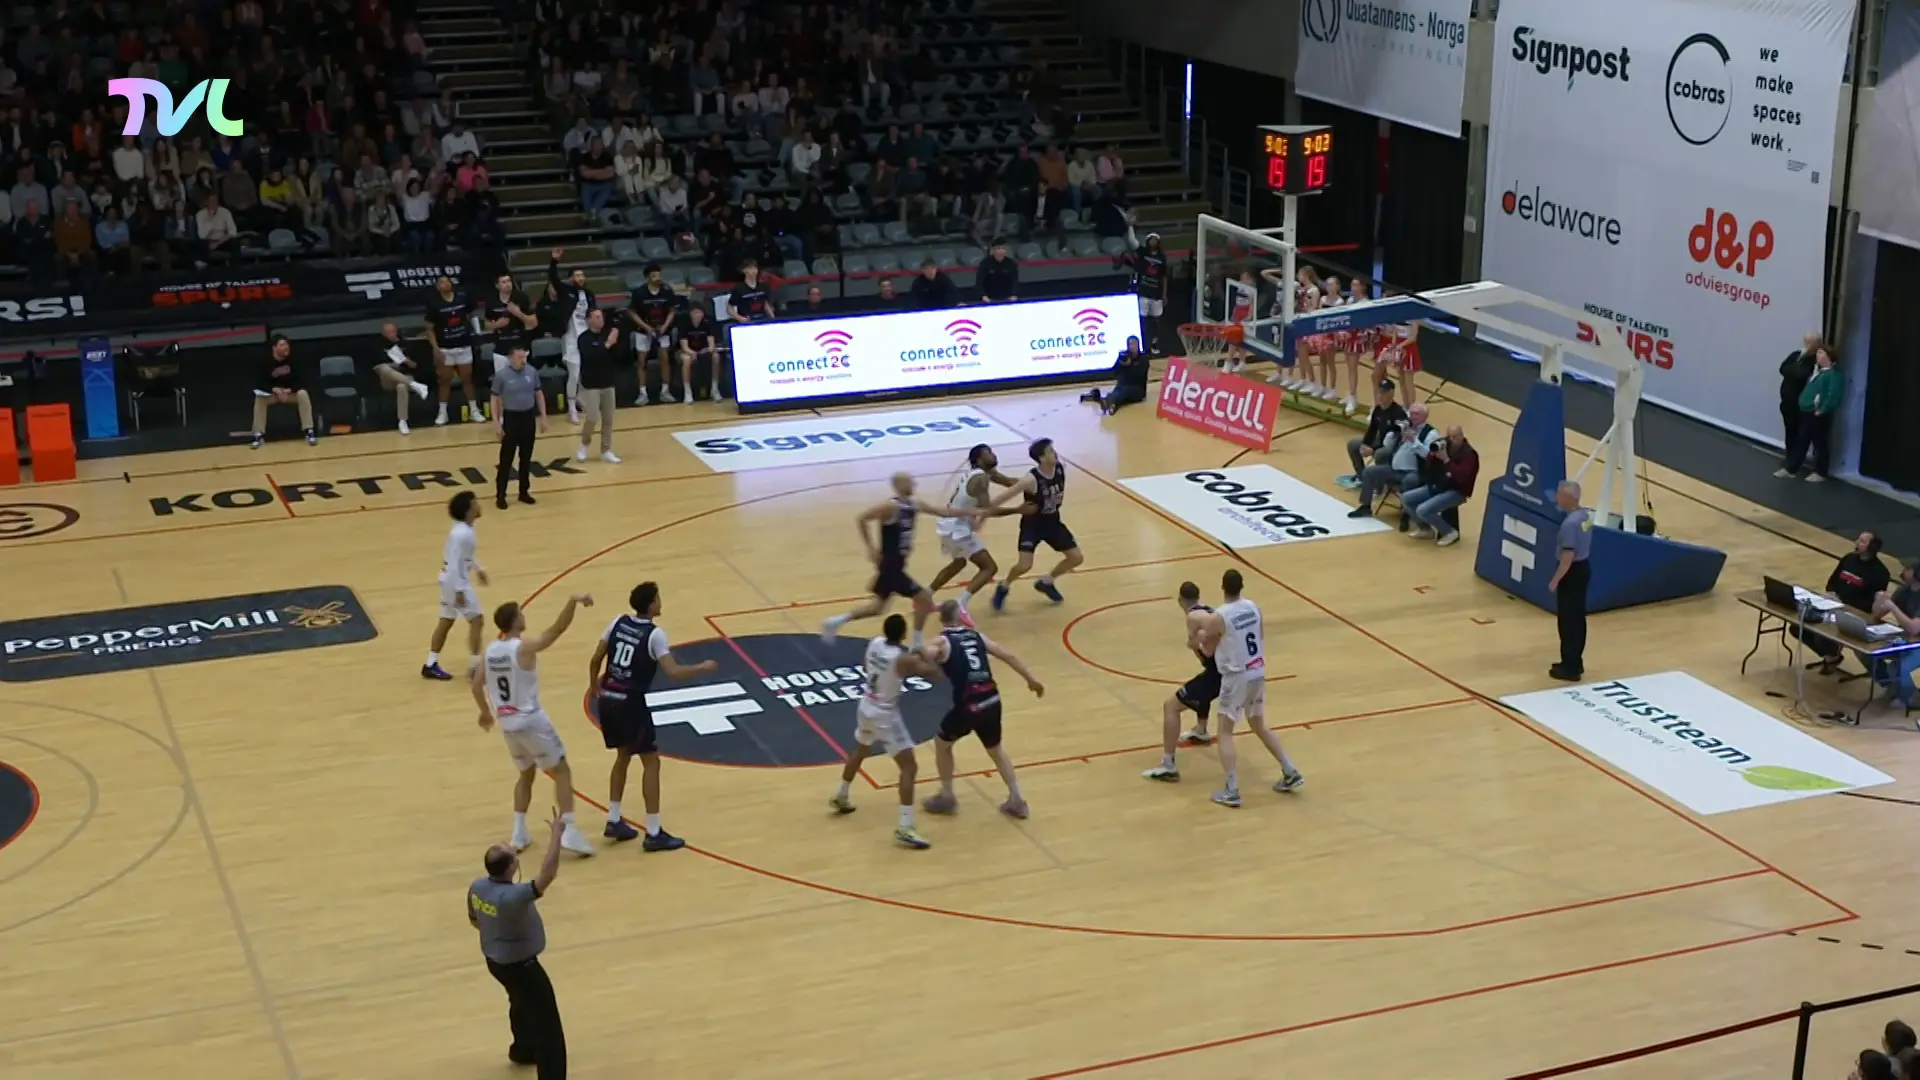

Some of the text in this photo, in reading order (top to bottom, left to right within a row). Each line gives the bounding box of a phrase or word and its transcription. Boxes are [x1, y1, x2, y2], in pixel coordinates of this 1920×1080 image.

[1427, 11, 1465, 48] Norga
[1512, 26, 1630, 86] Signpost
[1759, 47, 1779, 63] we
[1673, 80, 1726, 105] cobras
[1755, 74, 1793, 95] make
[1753, 103, 1801, 126] spaces
[1304, 133, 1330, 155] 9:03
[1502, 180, 1621, 245] delaware
[151, 284, 292, 307] SPURS
[1685, 272, 1770, 309] adviesgroep
[1584, 303, 1669, 339] HOUSE OF TALENTS
[1163, 365, 1265, 431] Hercull
[695, 415, 991, 454] Signpost
[1185, 471, 1330, 538] cobras
[4, 609, 280, 654] PepperMill
[1245, 632, 1258, 656] 6
[93, 635, 203, 655] FRIENDS
[613, 641, 635, 667] 10
[964, 647, 981, 670] 5
[497, 676, 511, 702] 9
[1592, 681, 1752, 764] Trustteam
